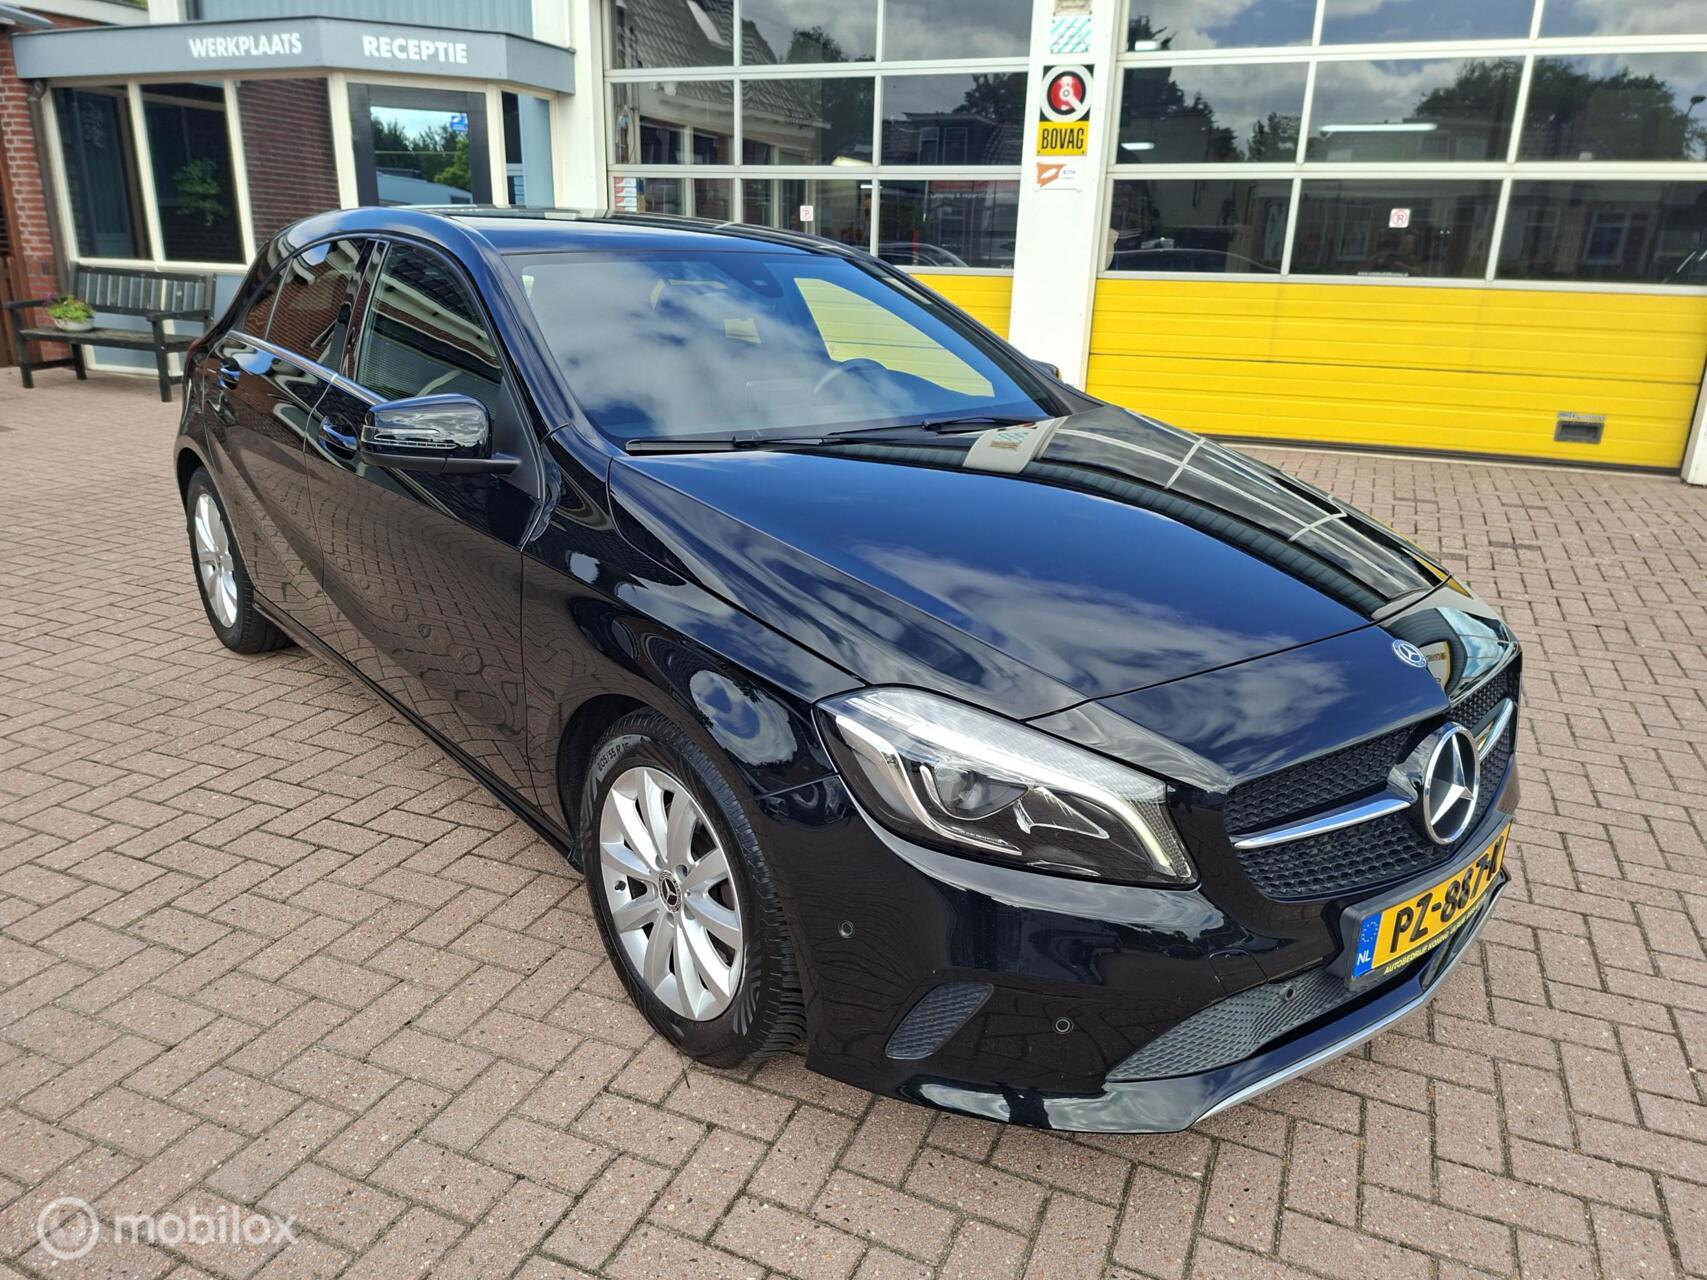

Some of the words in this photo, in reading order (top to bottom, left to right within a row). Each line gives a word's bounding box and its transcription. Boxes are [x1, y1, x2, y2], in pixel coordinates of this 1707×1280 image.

[188, 33, 302, 58] WERKPLAATS
[362, 35, 468, 64] RECEPTIE
[1041, 128, 1084, 150] BOVAG
[1357, 950, 1372, 966] NL
